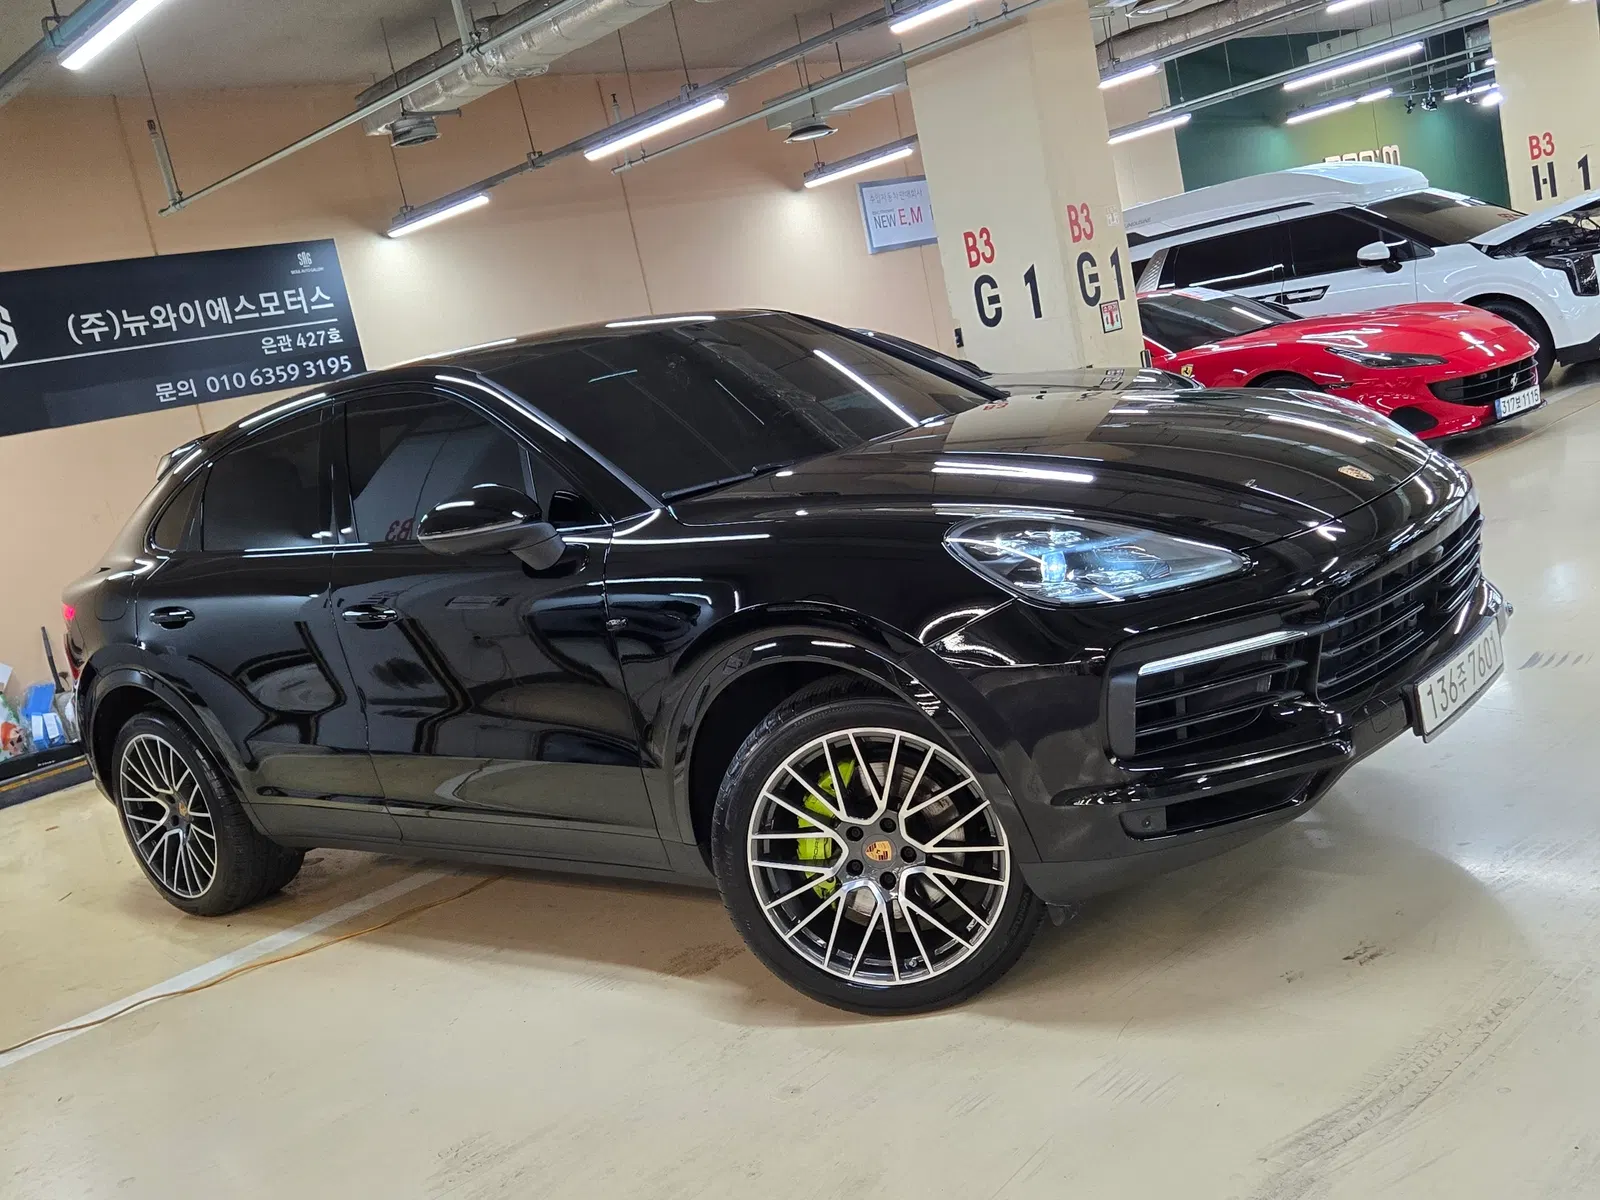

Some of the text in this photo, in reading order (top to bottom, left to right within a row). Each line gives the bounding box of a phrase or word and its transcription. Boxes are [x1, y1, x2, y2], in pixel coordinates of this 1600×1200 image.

[1528, 132, 1555, 160] B3
[1532, 154, 1591, 201] H 1
[873, 213, 897, 230] NEW
[1066, 202, 1095, 243] B3
[963, 227, 995, 268] B3
[974, 263, 1042, 327] G 1
[1076, 247, 1126, 307] G 1
[67, 286, 335, 345] (주)뉴와이에스모터스
[261, 327, 344, 356] 은관 427호
[155, 356, 352, 403] 문의 010 6359 3195
